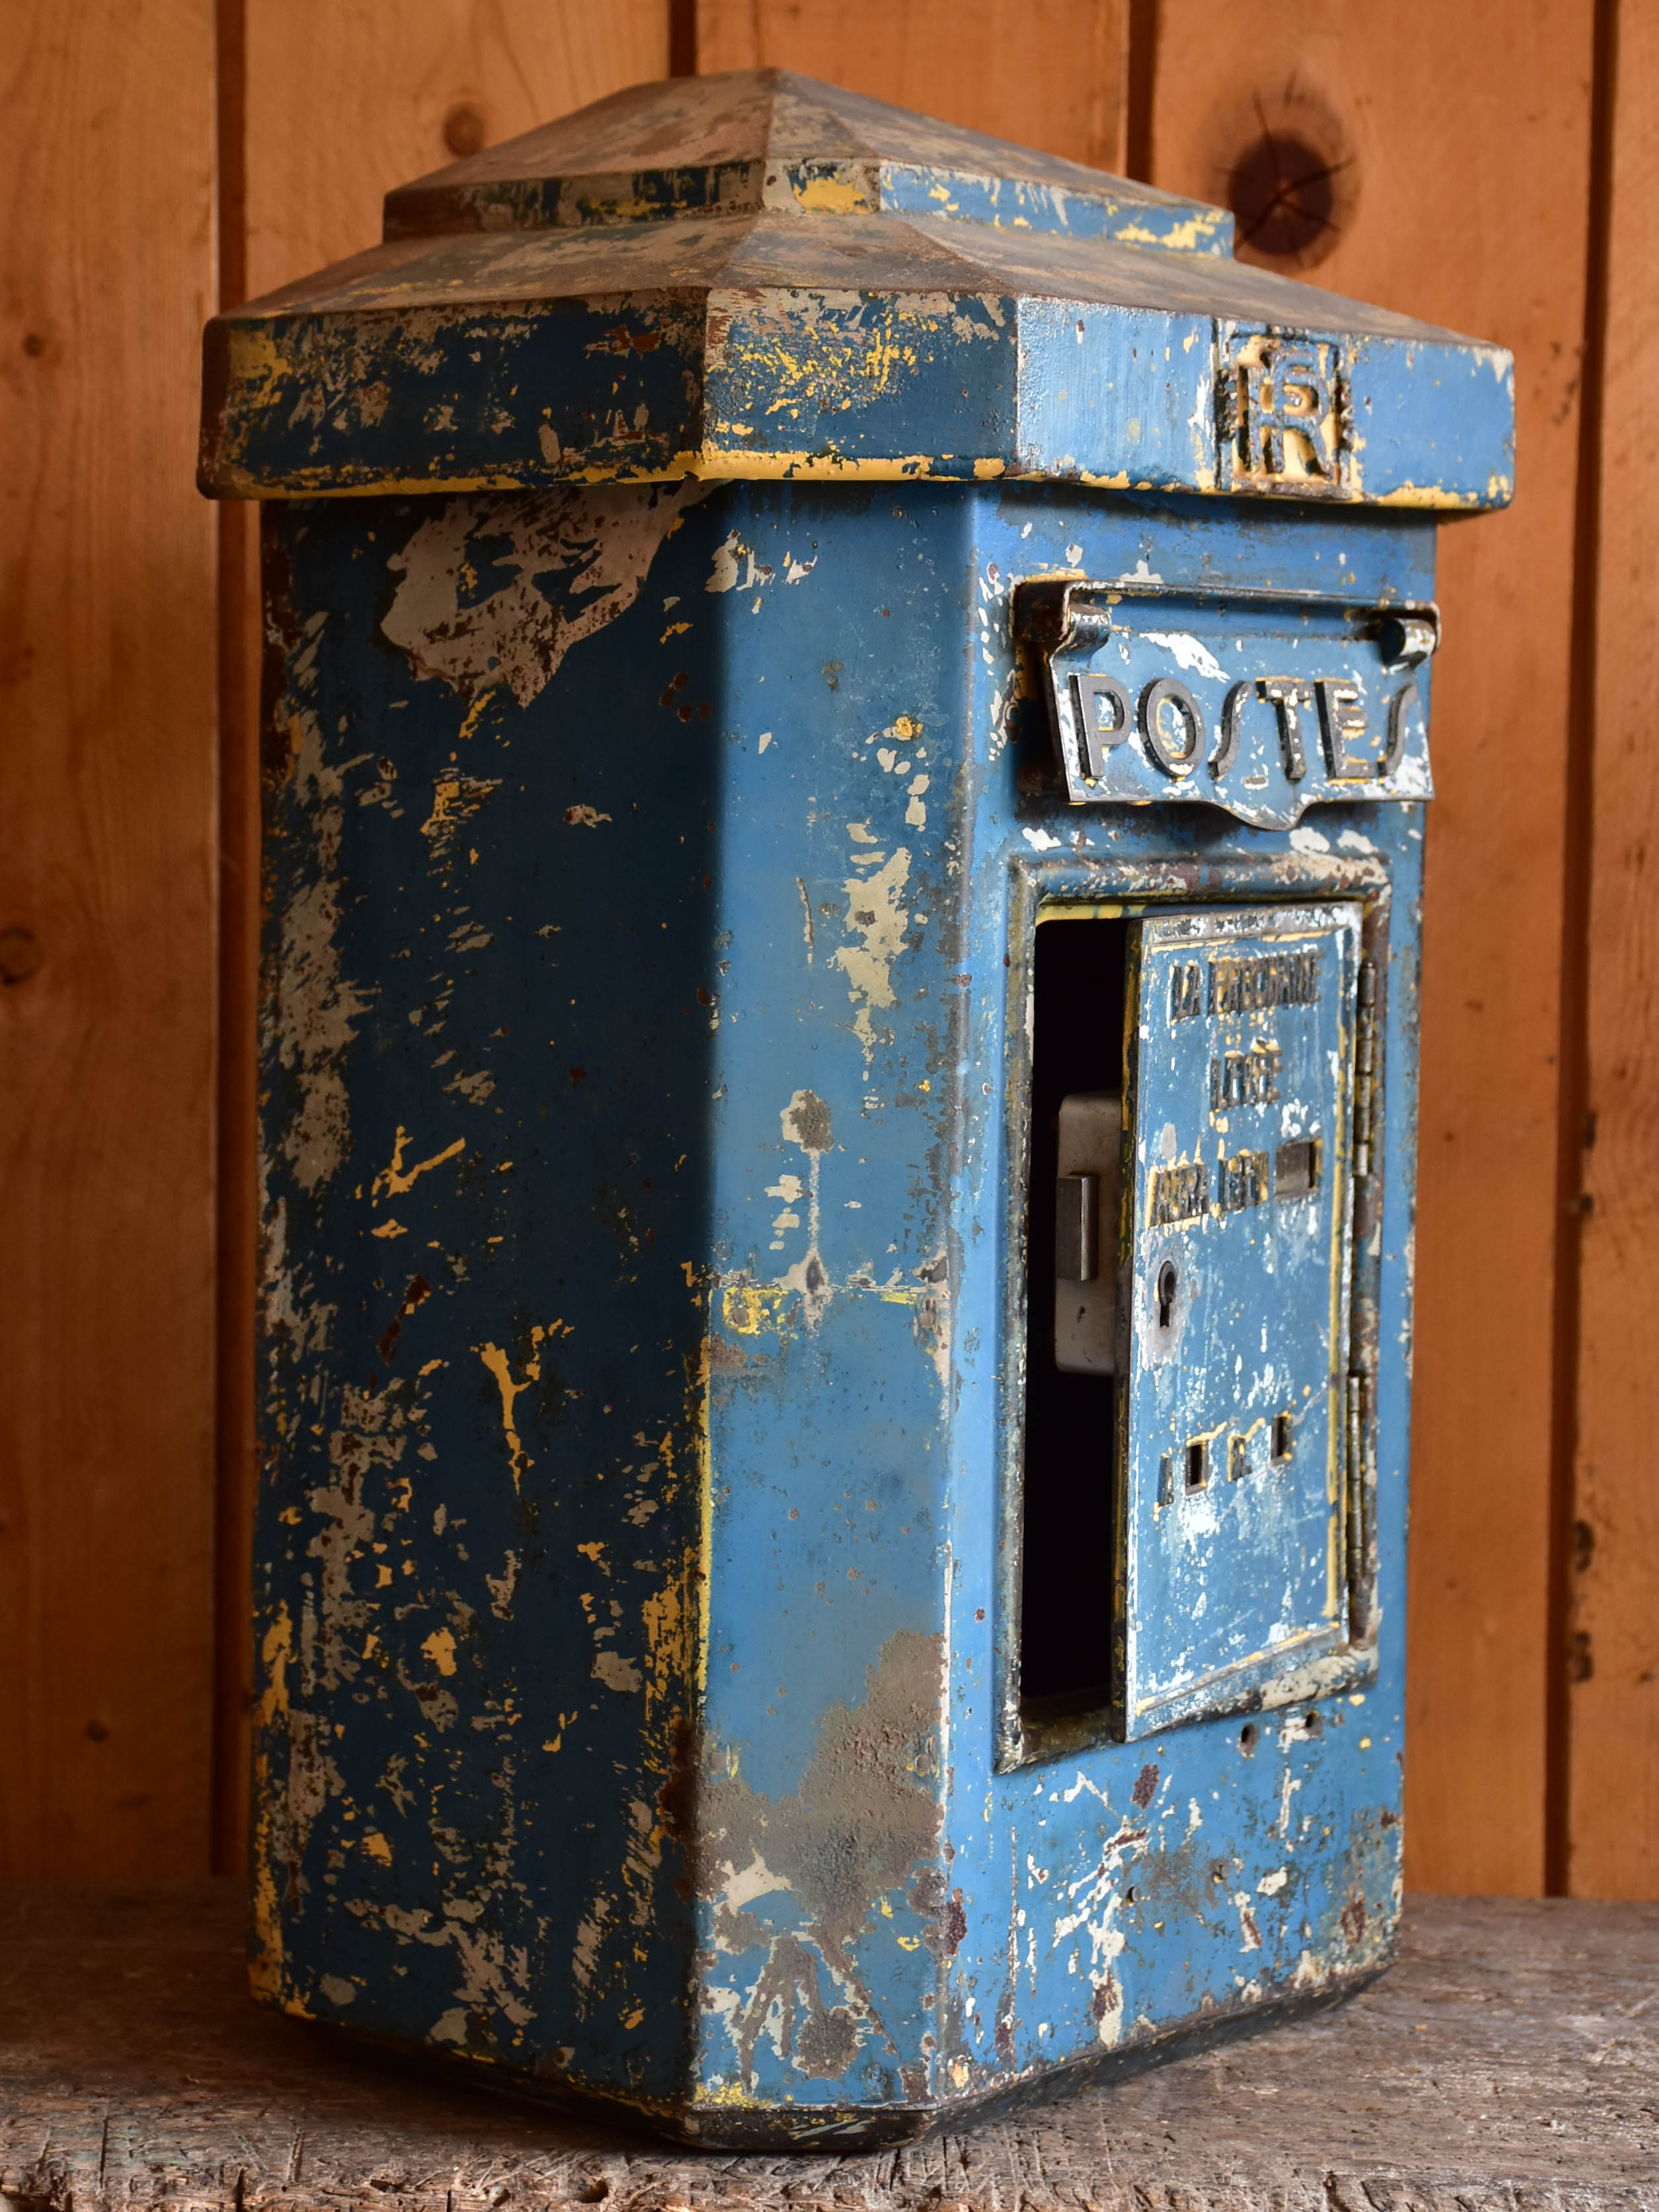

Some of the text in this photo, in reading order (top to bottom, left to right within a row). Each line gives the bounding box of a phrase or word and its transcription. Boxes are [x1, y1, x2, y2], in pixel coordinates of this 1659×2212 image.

[1066, 672, 1419, 782] POSTES
[1166, 950, 1323, 1020] LA PROCHAINE
